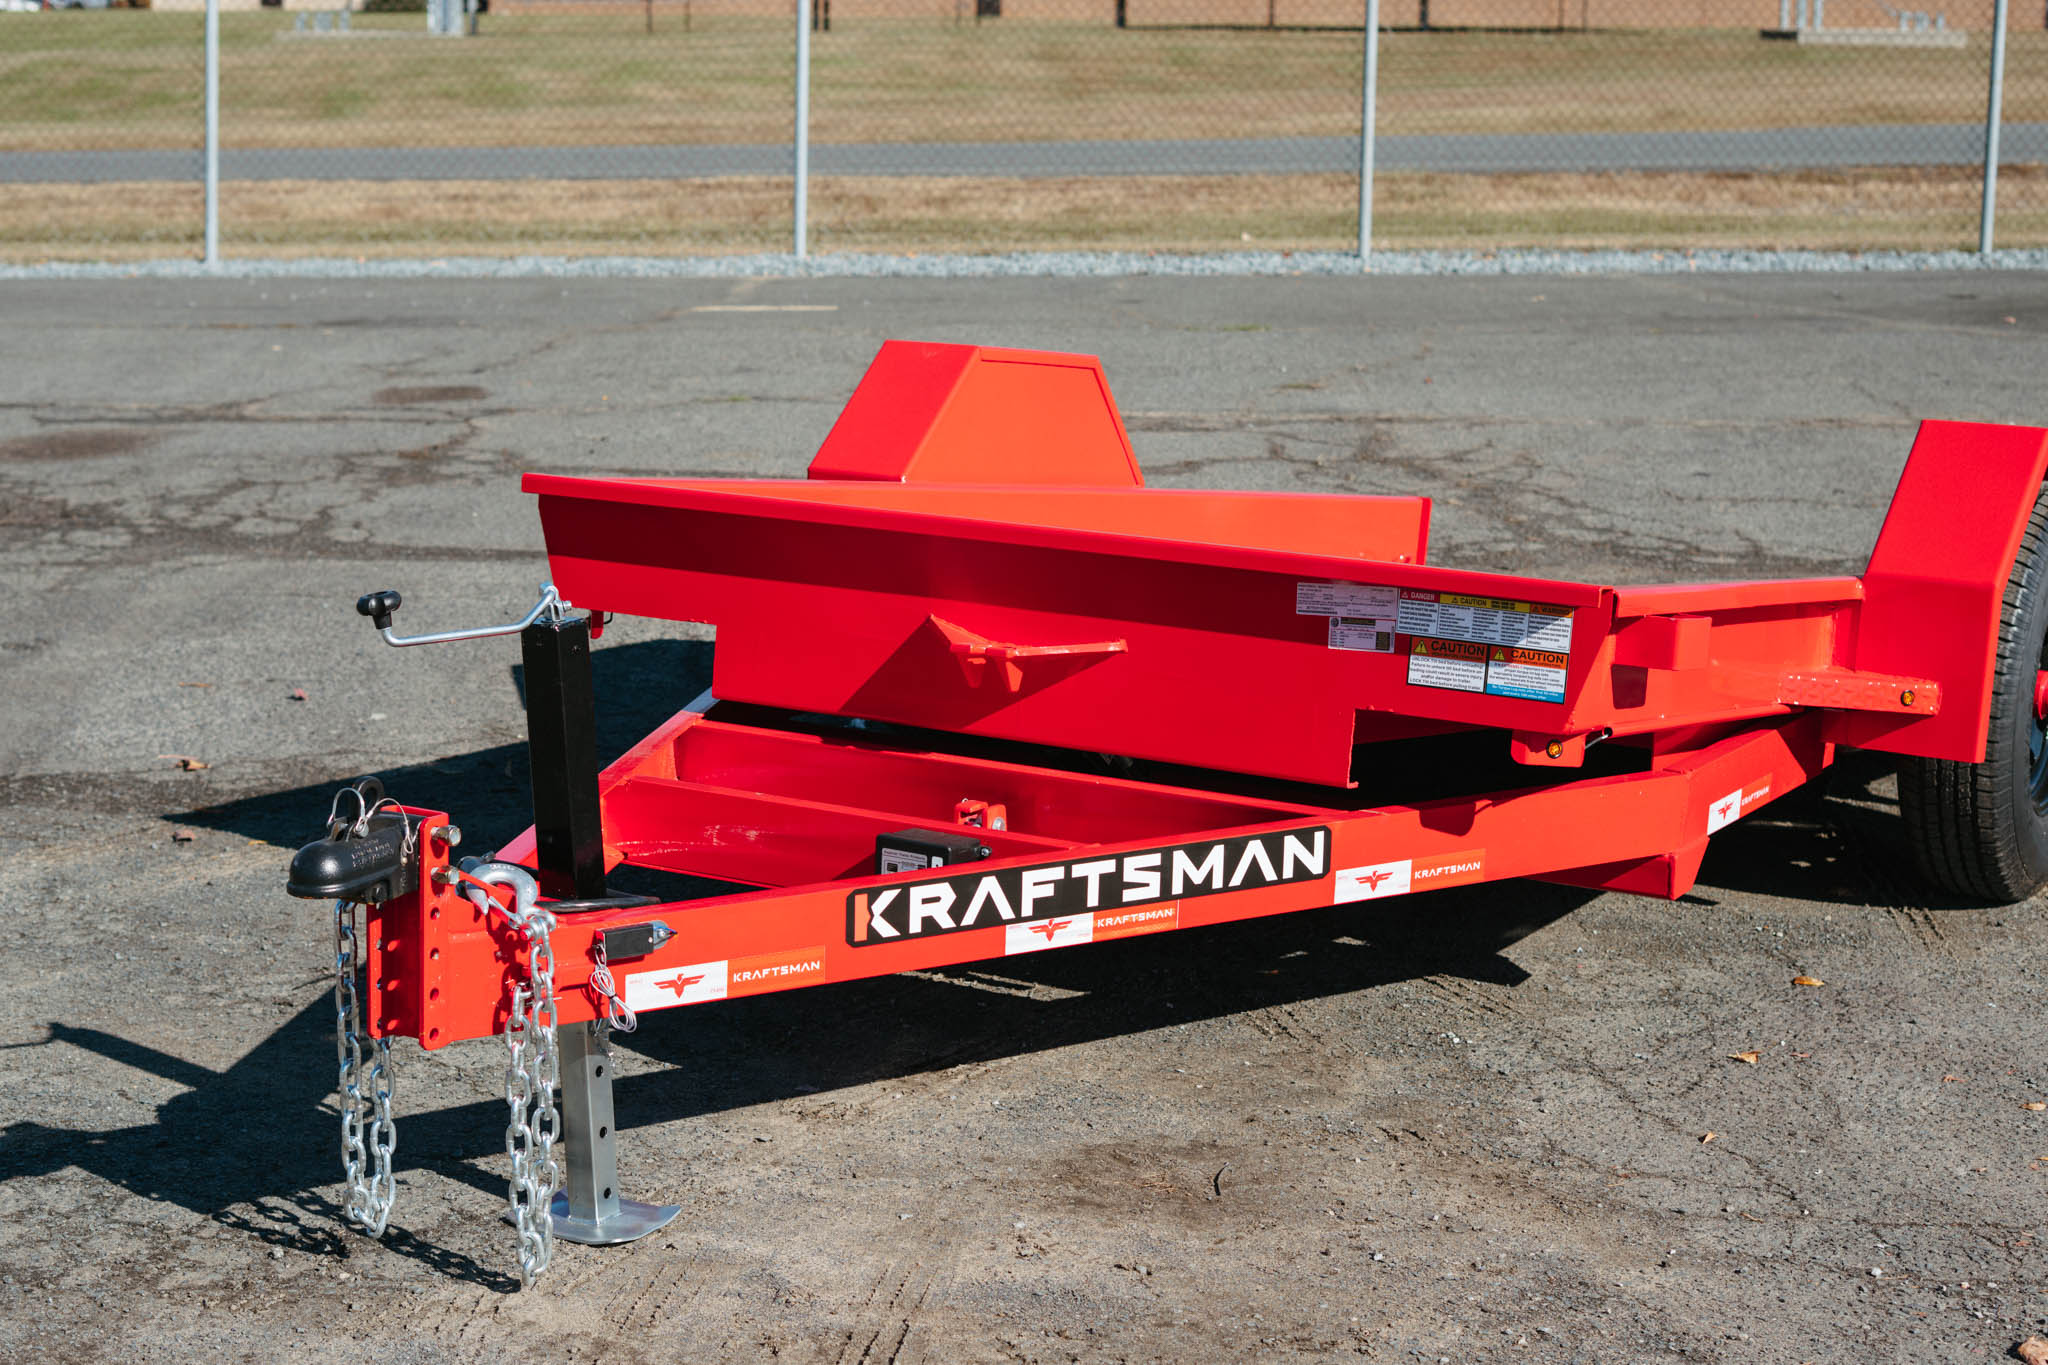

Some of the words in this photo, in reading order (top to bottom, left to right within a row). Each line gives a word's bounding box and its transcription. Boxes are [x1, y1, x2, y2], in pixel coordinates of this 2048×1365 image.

[1411, 592, 1435, 601] DANGER
[1460, 598, 1487, 606] CAUTION
[1431, 640, 1485, 656] CAUTION
[1511, 650, 1564, 664] CAUTION
[1415, 861, 1481, 880] KRAFTSMAN
[854, 830, 1325, 942] KRAFTSMAN
[1097, 908, 1173, 928] KRAFTSMAN
[733, 960, 820, 983] KRAFTSMAN
